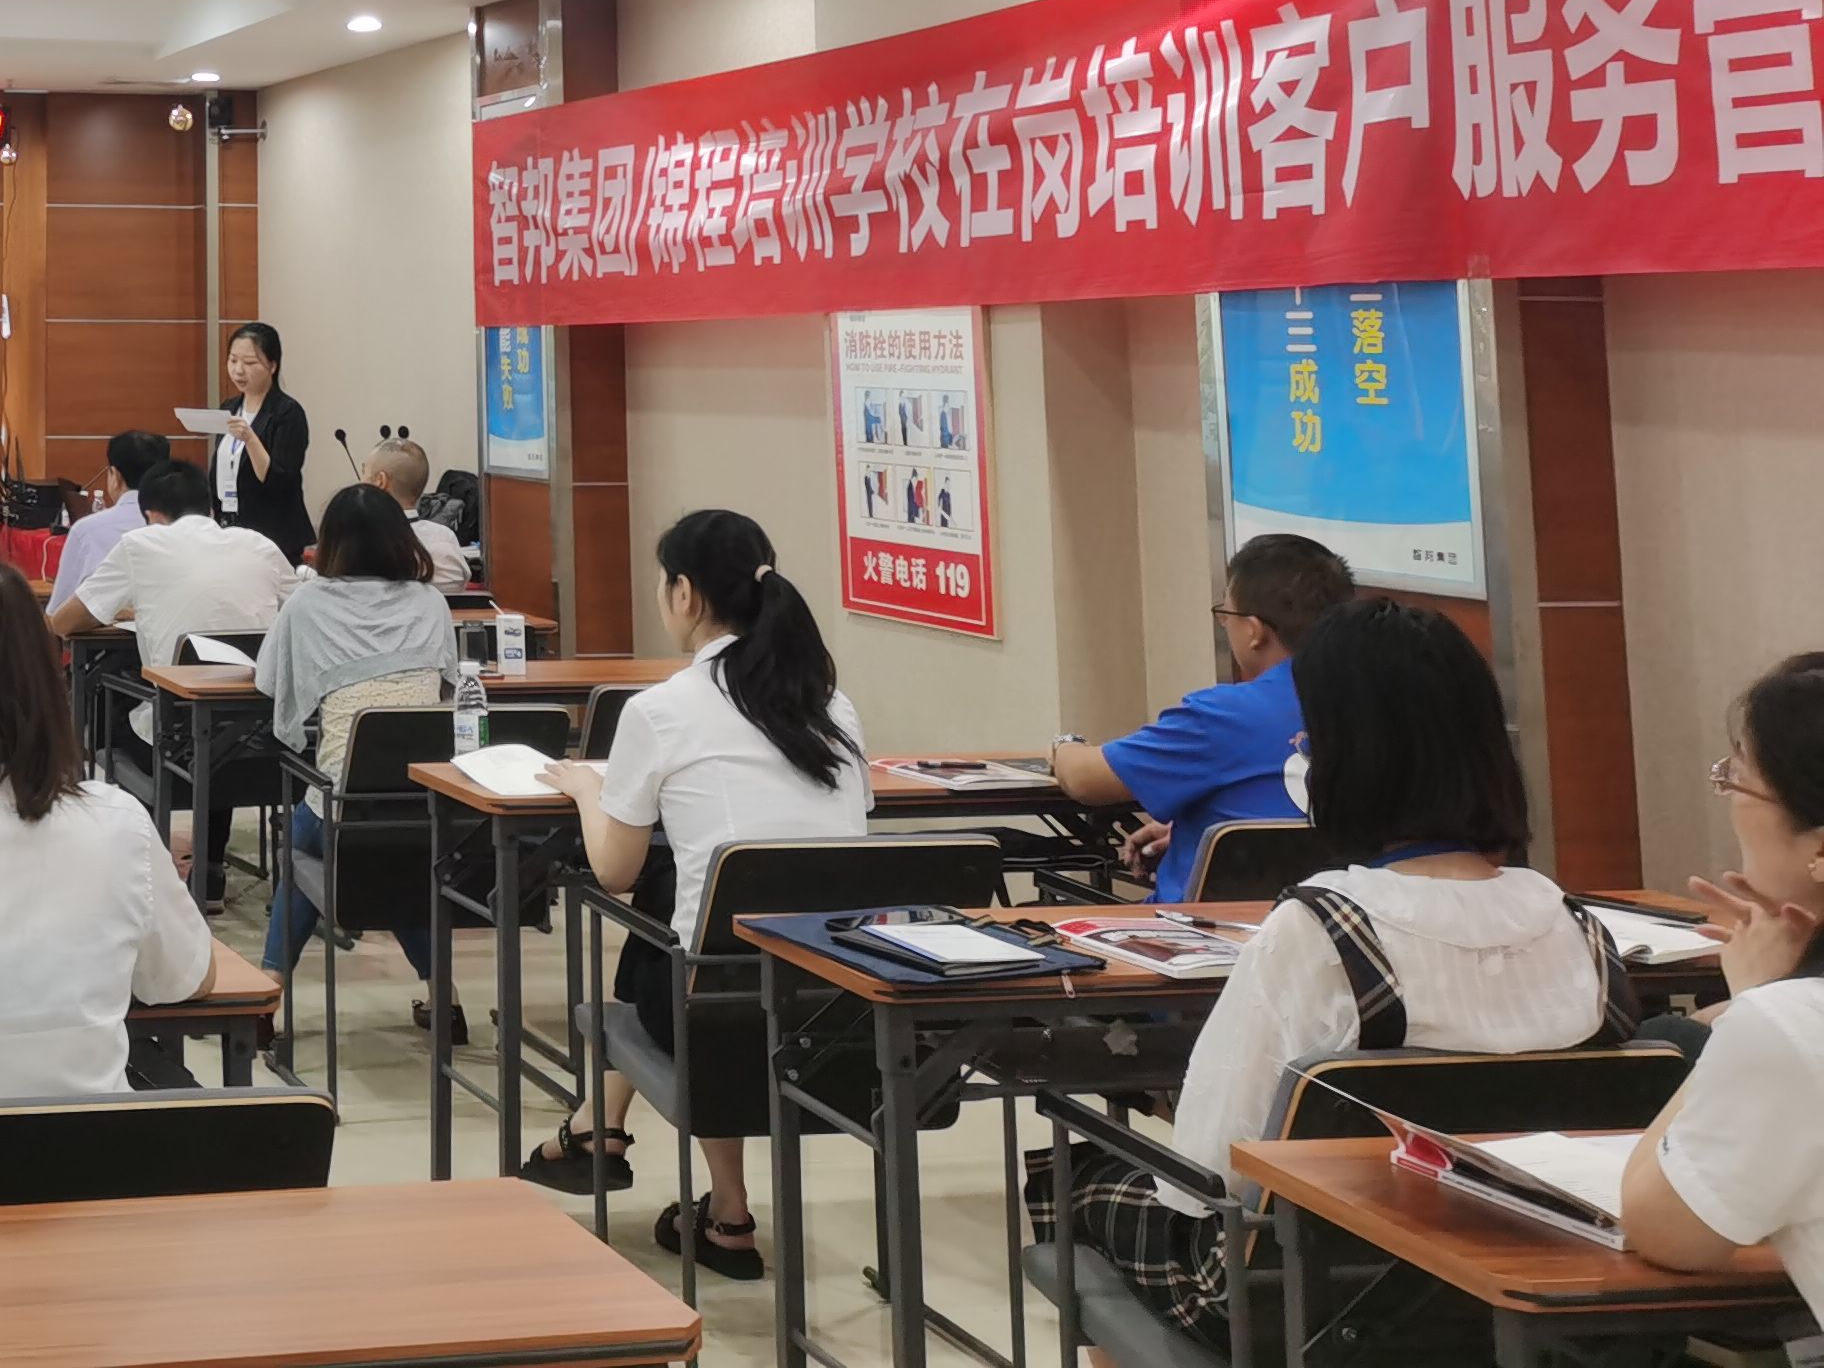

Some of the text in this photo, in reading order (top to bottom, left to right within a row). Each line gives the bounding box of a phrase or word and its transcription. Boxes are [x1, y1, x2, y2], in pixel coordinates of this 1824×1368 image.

[844, 329, 964, 361] 消防栓的使用方法
[863, 550, 971, 598] 火警电话 119
